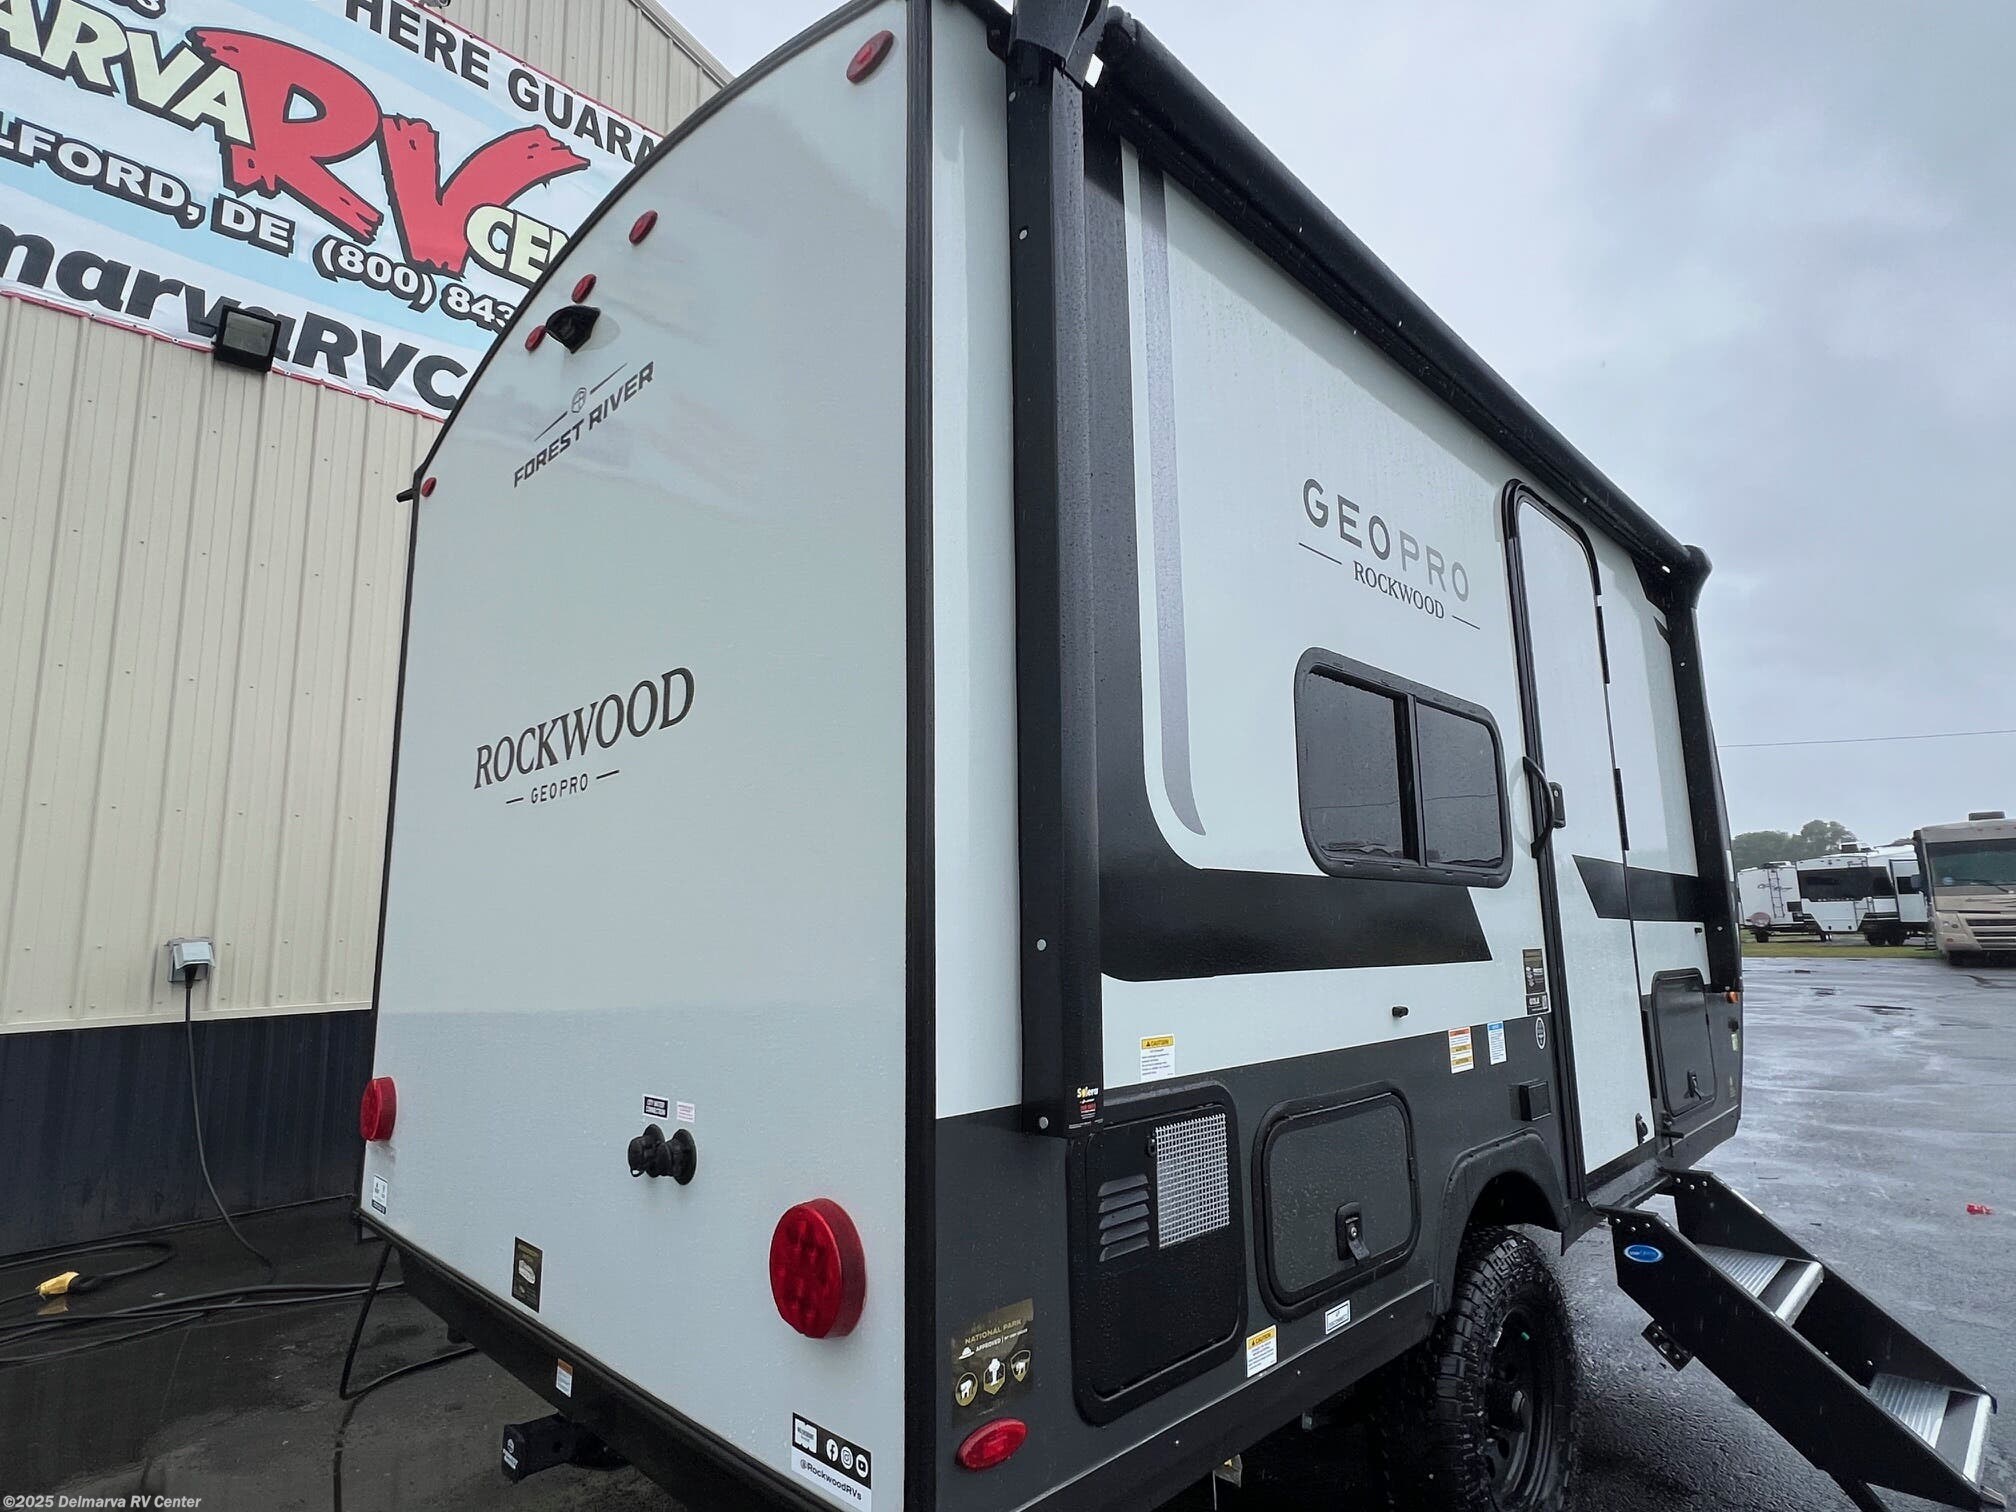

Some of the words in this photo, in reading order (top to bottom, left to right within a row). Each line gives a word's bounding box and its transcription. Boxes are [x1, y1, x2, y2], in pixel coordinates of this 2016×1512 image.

[345, 0, 490, 90] HERE
[186, 27, 590, 278] RV
[217, 197, 294, 253] DE
[317, 236, 435, 308] (800)
[513, 418, 585, 488] FOREST
[588, 361, 654, 430] RIVER
[1302, 478, 1469, 602] GEOPRO
[1353, 560, 1445, 619] ROCKWOOD
[473, 667, 695, 789] ROCKWOOD
[530, 773, 588, 804] GEOPRO
[964, 1326, 1002, 1345] NATIONAL
[1002, 1318, 1022, 1331] PARK
[800, 1458, 862, 1501] @RockwoodRVs
